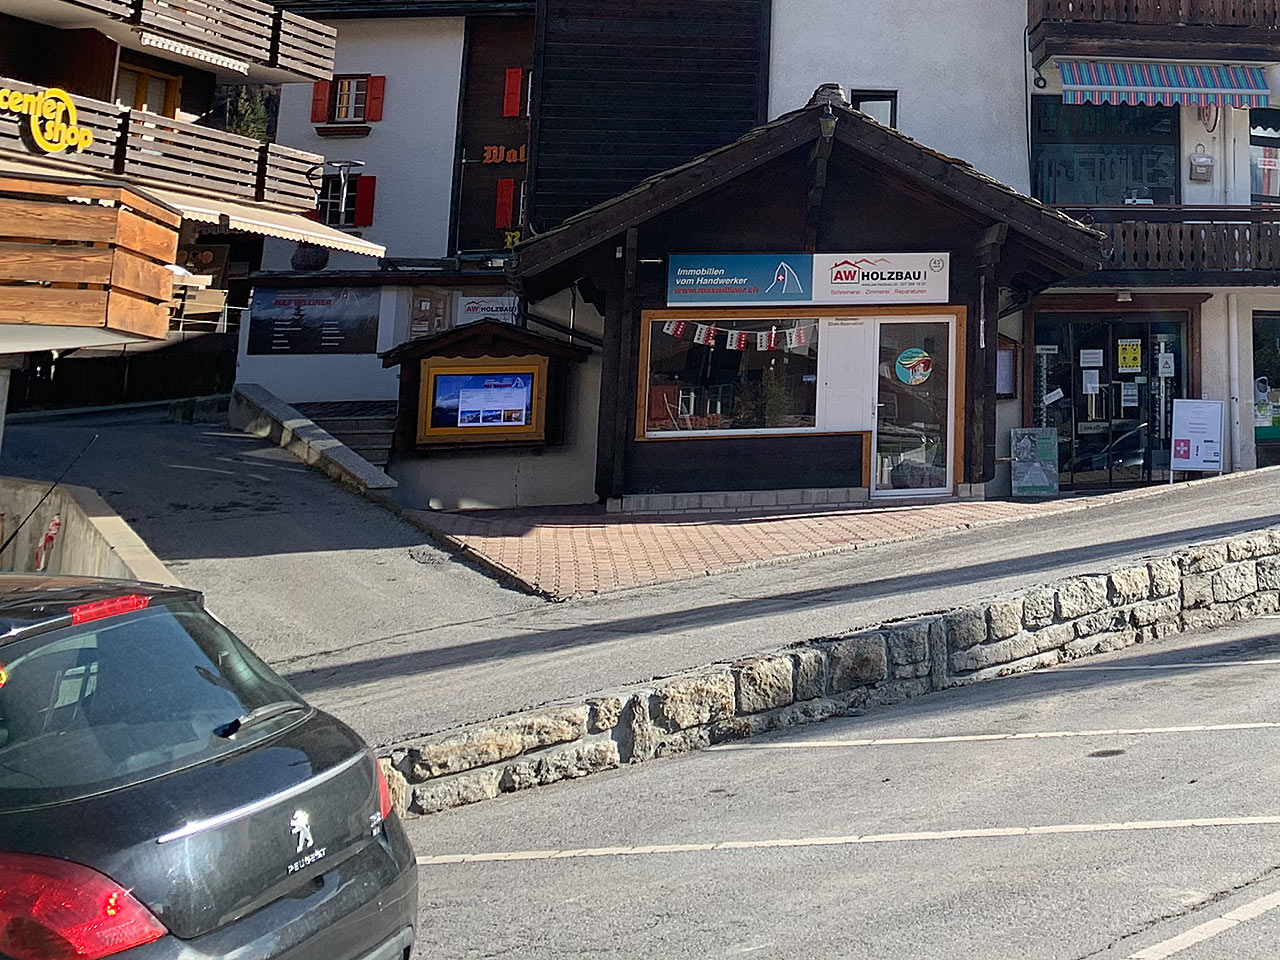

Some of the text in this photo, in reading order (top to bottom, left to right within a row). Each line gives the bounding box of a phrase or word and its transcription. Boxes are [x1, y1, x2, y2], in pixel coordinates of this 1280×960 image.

[0, 88, 66, 120] center
[44, 119, 93, 153] shop
[676, 267, 725, 276] Immobilien
[833, 270, 922, 281] AW HOLZBAU
[675, 276, 748, 285] vom Handwerker
